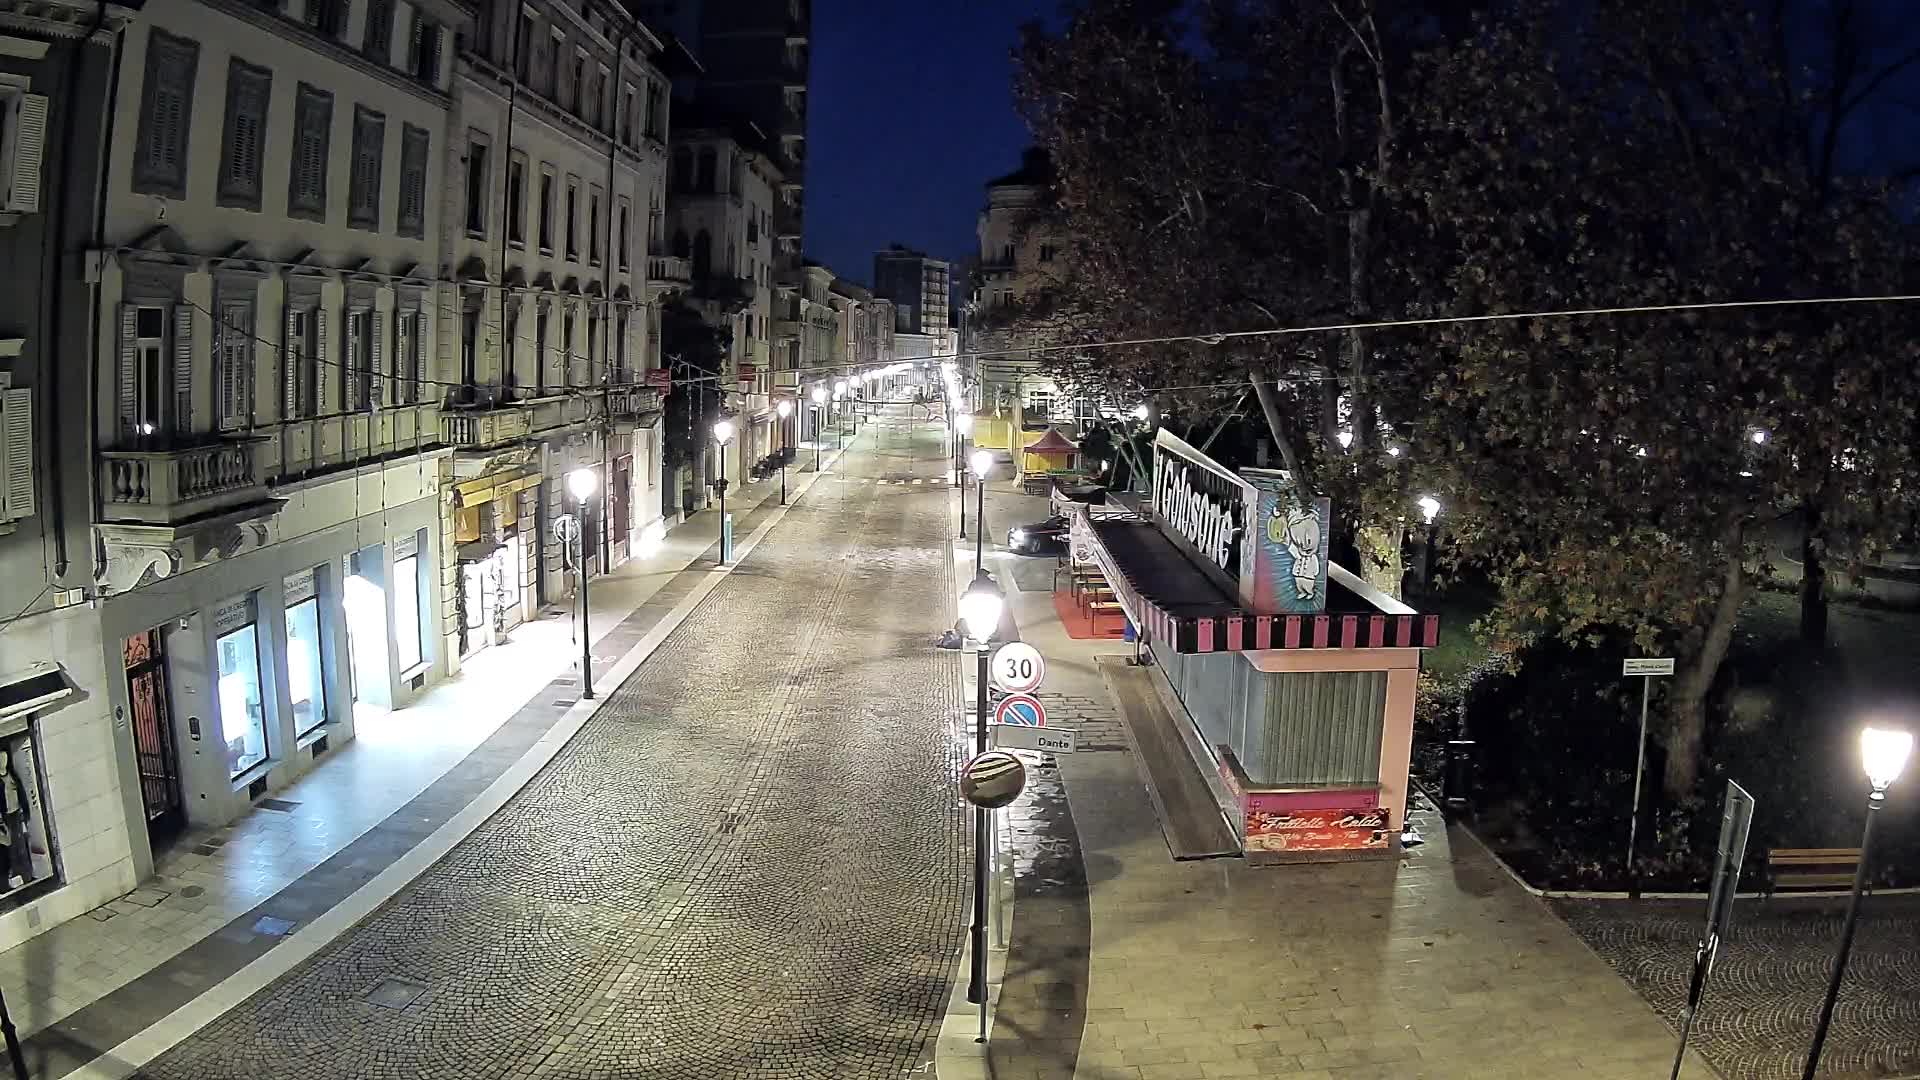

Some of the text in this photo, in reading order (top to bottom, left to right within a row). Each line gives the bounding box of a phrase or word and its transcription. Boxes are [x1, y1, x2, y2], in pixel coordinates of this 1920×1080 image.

[1006, 658, 1032, 679] 30
[1038, 737, 1070, 749] Dante
[1330, 816, 1382, 829] Calde
